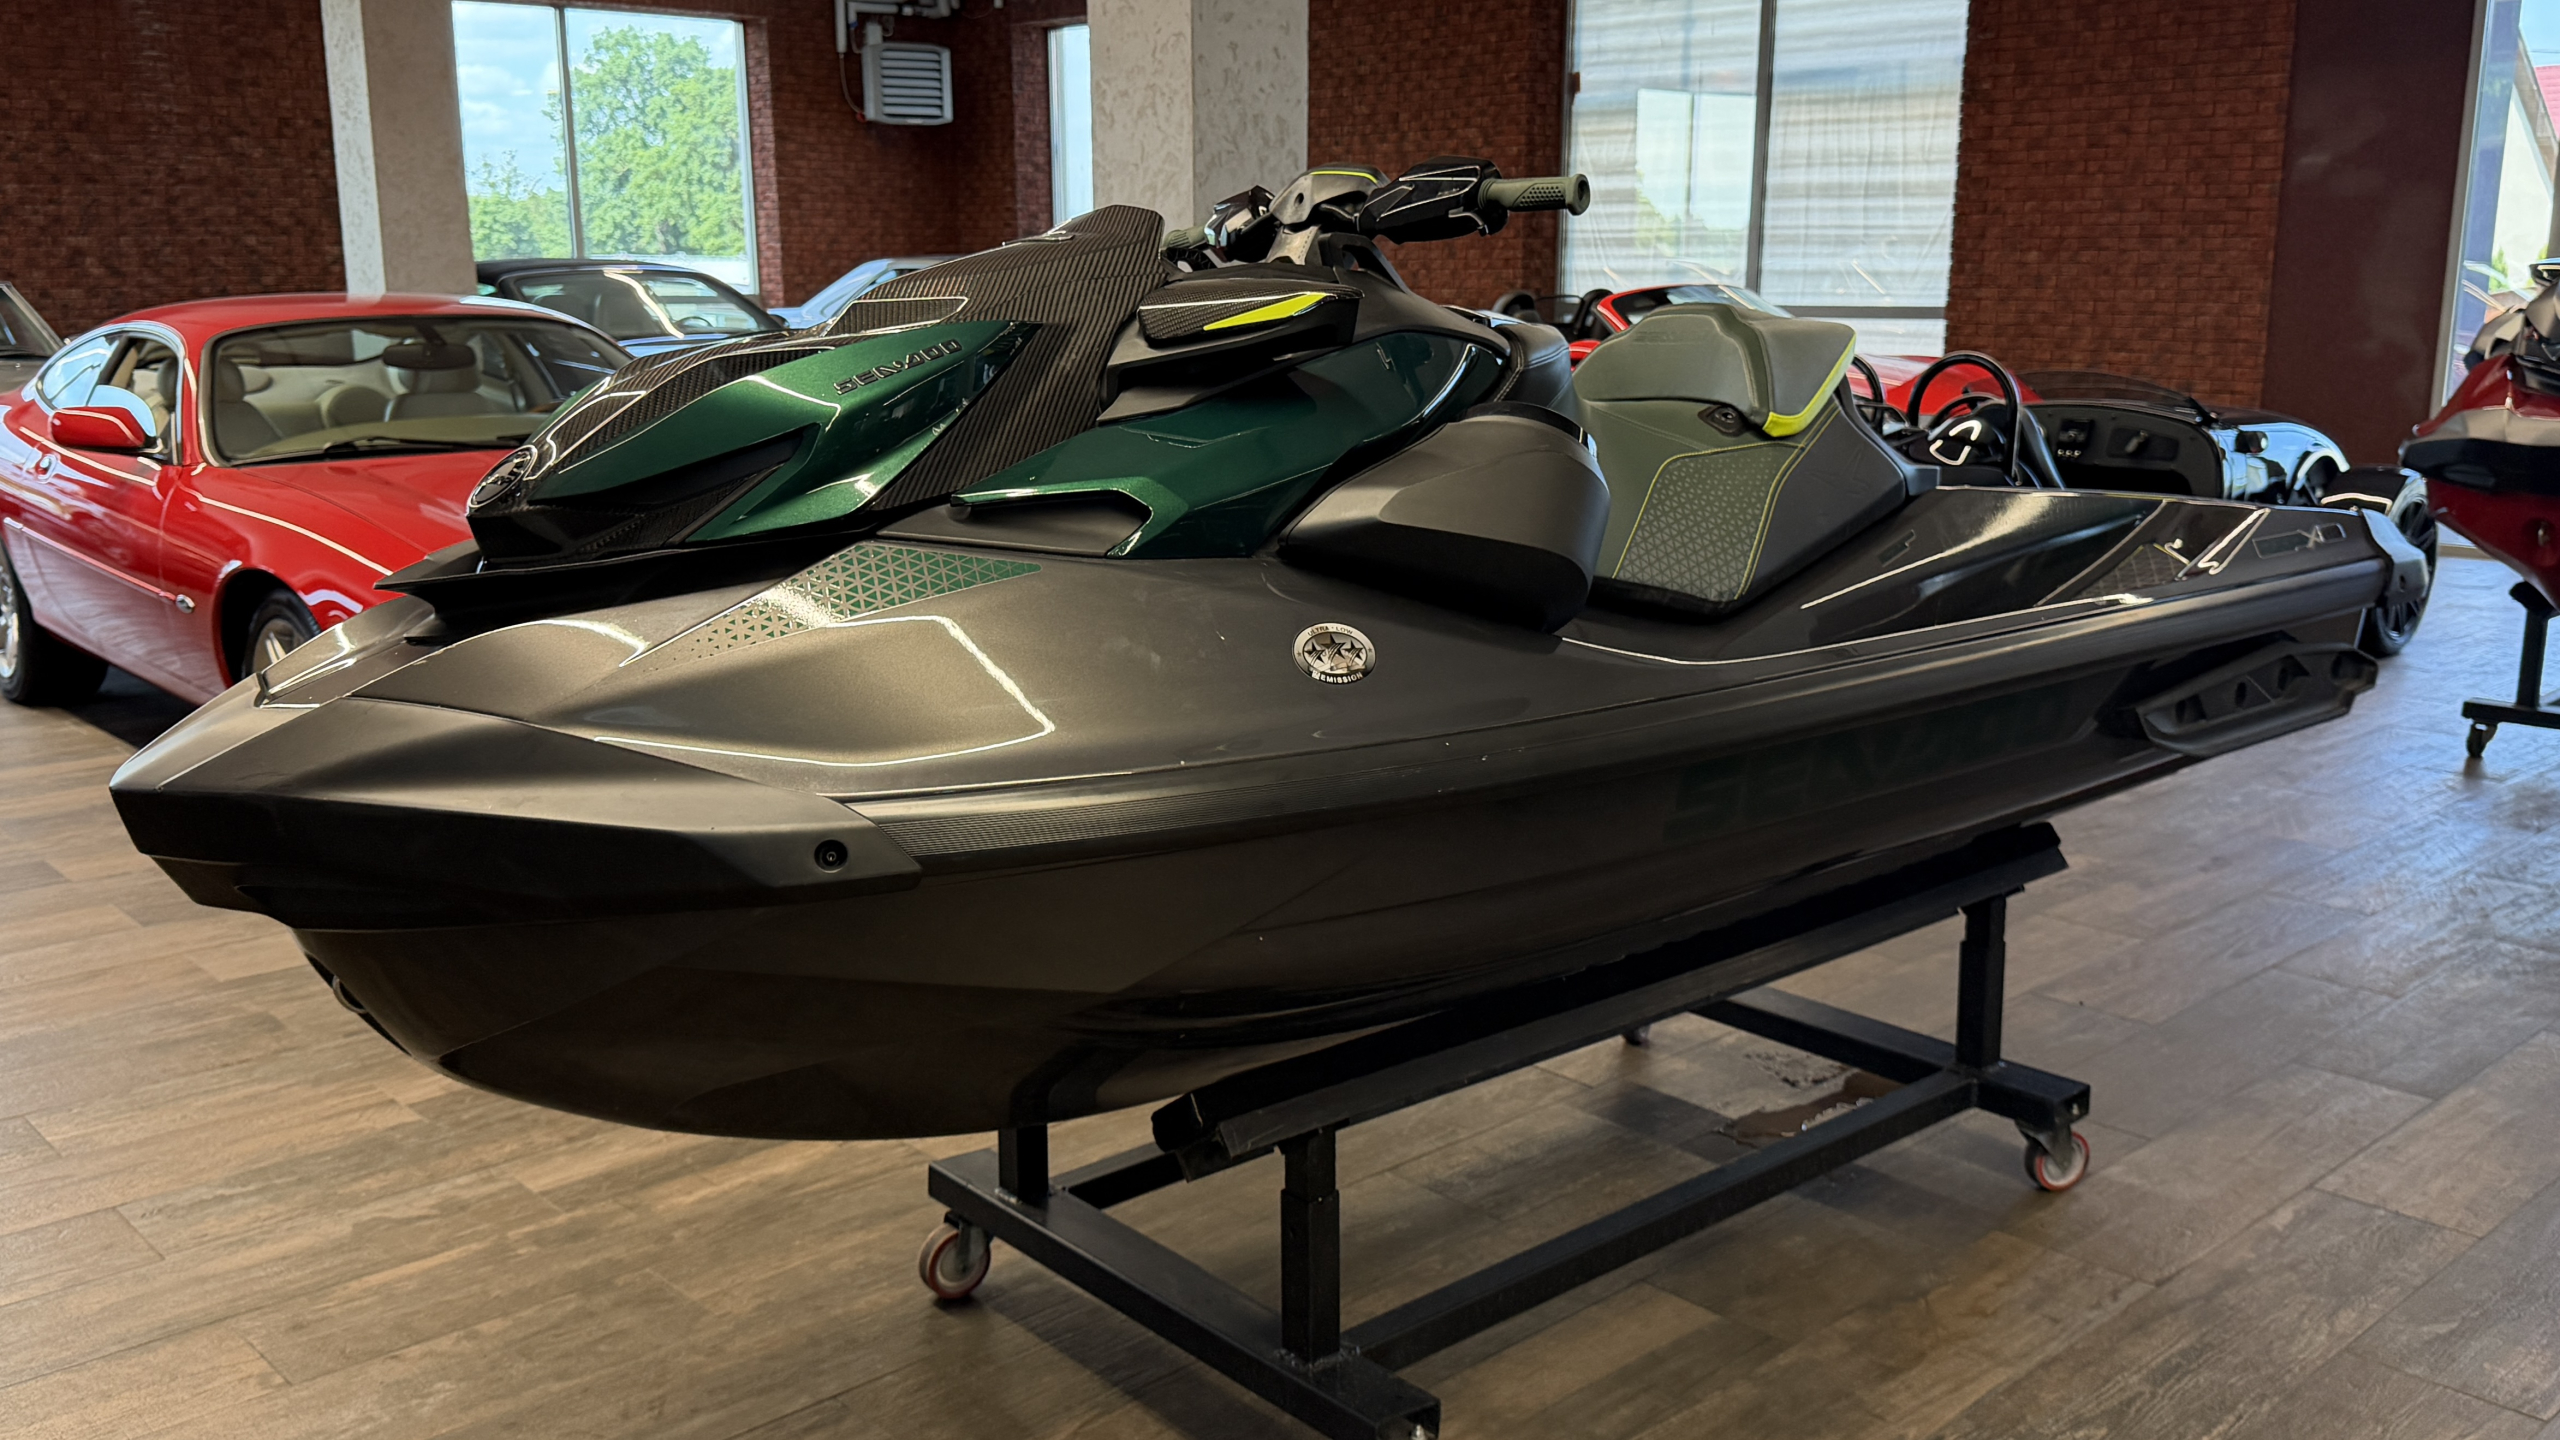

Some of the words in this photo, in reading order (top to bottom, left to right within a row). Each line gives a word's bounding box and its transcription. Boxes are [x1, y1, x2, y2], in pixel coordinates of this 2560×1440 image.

[1307, 625, 1330, 637] ULTRA
[1335, 626, 1354, 636] LOW
[1320, 671, 1363, 684] EMISSION
